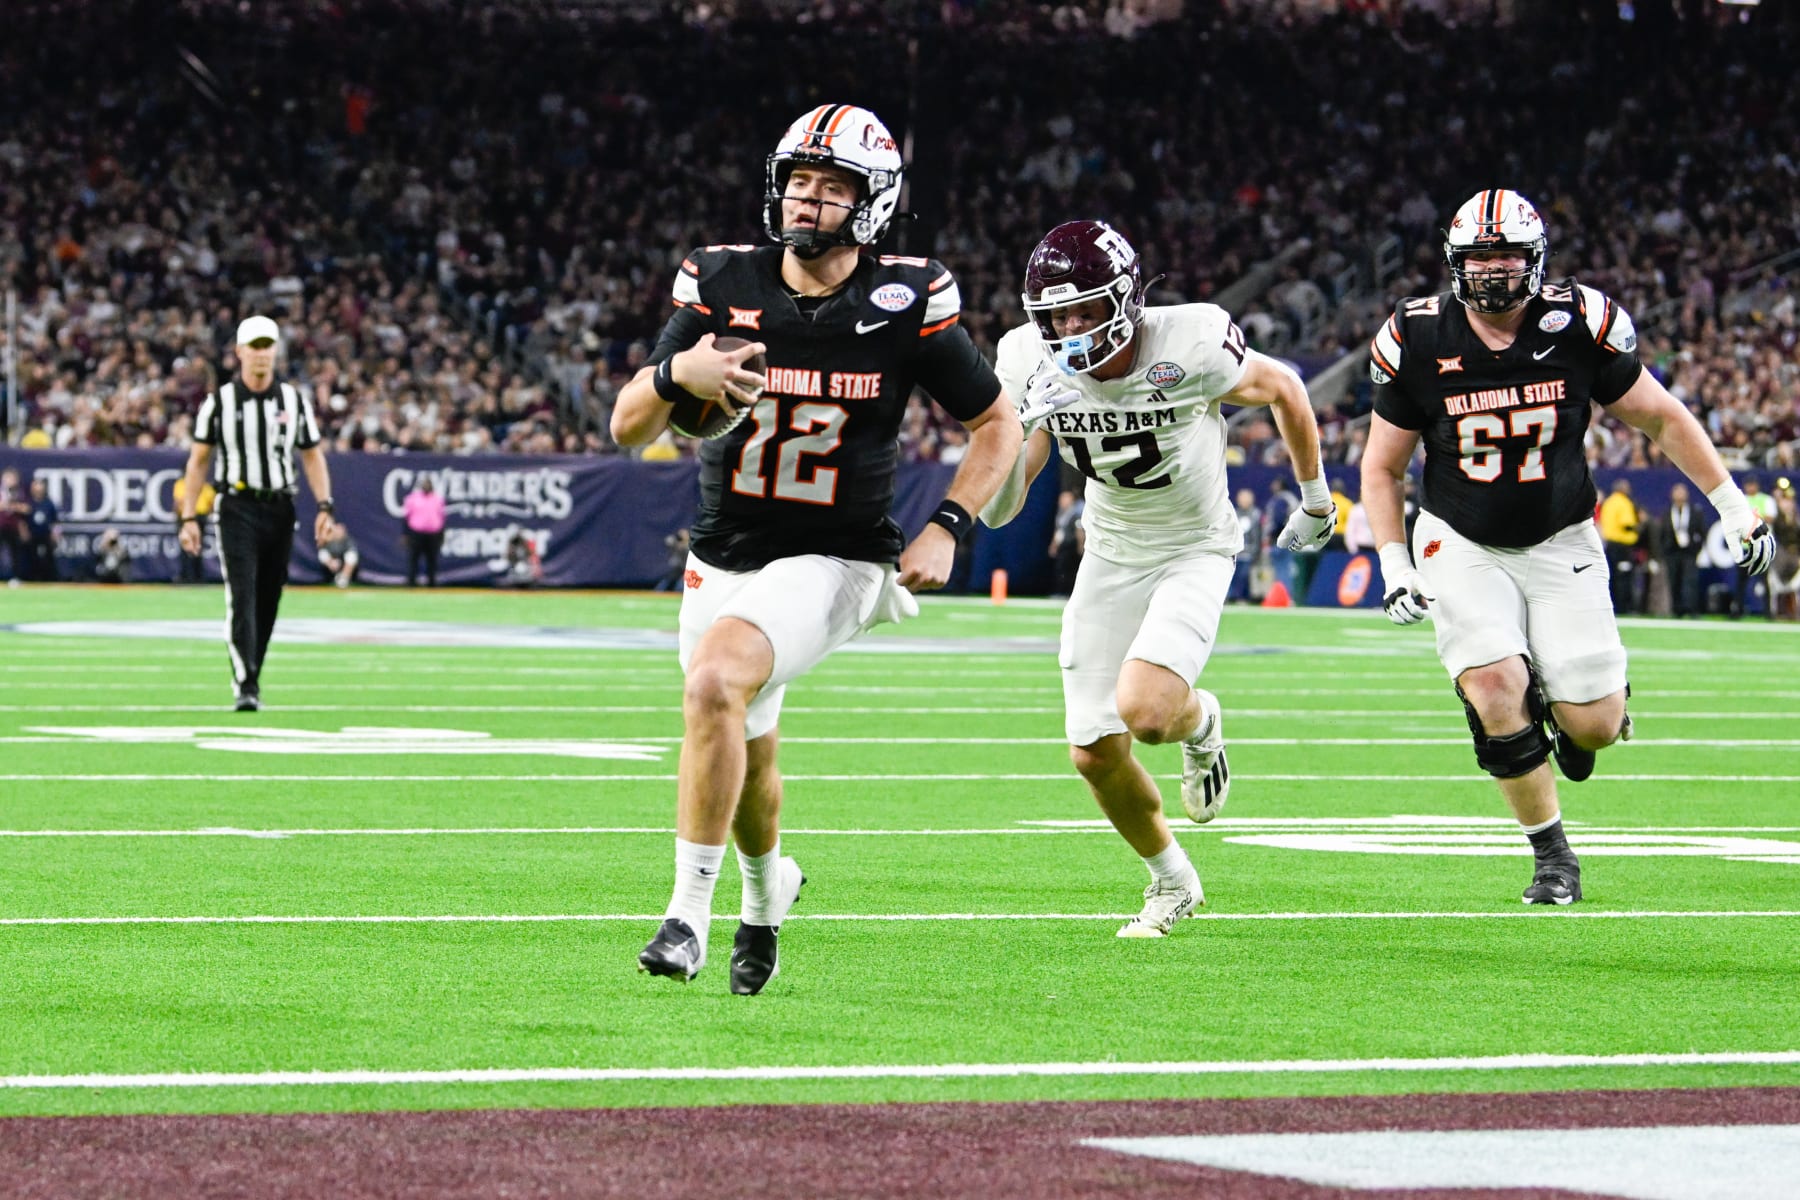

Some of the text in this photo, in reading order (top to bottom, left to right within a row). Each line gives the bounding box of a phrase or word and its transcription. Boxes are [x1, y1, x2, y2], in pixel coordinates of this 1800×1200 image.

[878, 291, 909, 301] TEXAS
[1543, 315, 1567, 326] TEXAS
[829, 372, 882, 399] STATE
[1152, 370, 1180, 379] TEXAS
[1444, 380, 1566, 416] OKLAHOMA STATE
[1046, 407, 1177, 433] TEXAS A&M
[731, 397, 850, 506] 12
[1457, 403, 1558, 483] 67
[1061, 430, 1173, 490] 12
[33, 468, 187, 522] TDEC
